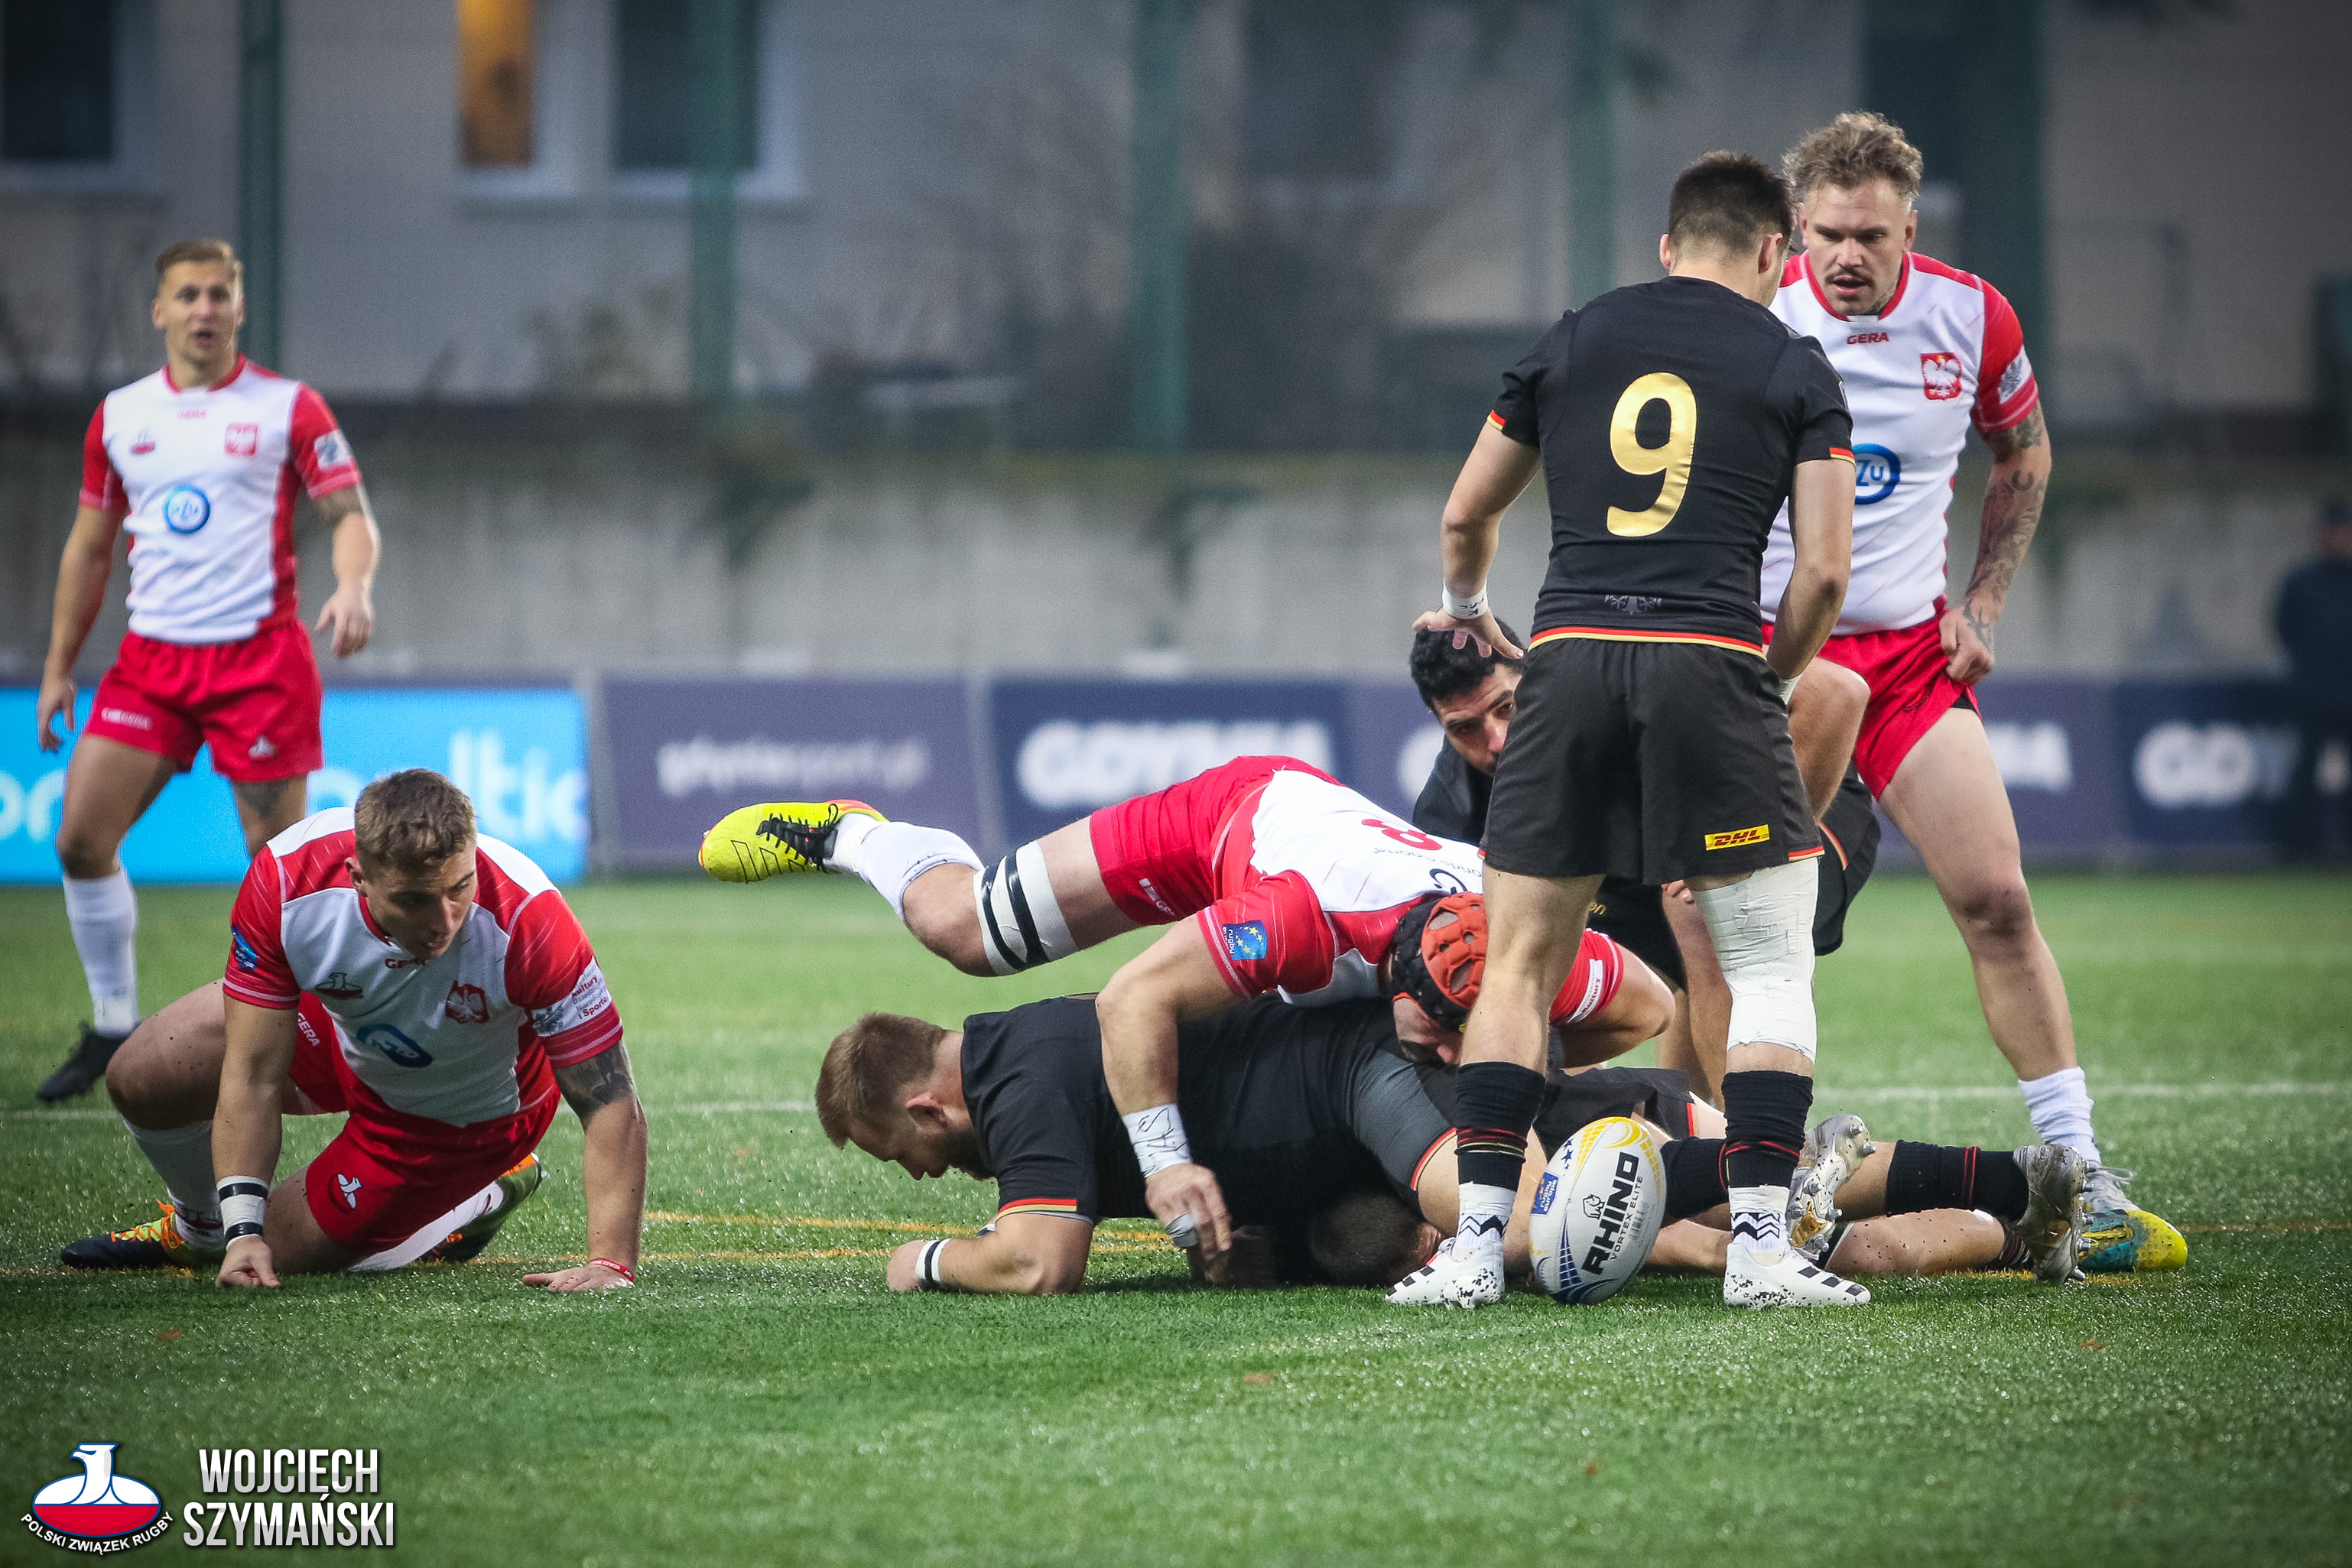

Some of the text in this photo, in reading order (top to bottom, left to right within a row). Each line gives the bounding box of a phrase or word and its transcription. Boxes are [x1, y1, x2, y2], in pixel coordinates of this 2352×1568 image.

[1847, 332, 1889, 344] GERA
[1606, 372, 1697, 537] 9
[1714, 829, 1761, 846] DHL
[583, 997, 608, 1017] Sportu
[1581, 1151, 1639, 1275] RHINO
[1610, 1214, 1633, 1260] VORTEX
[1629, 1176, 1643, 1209] ELITE
